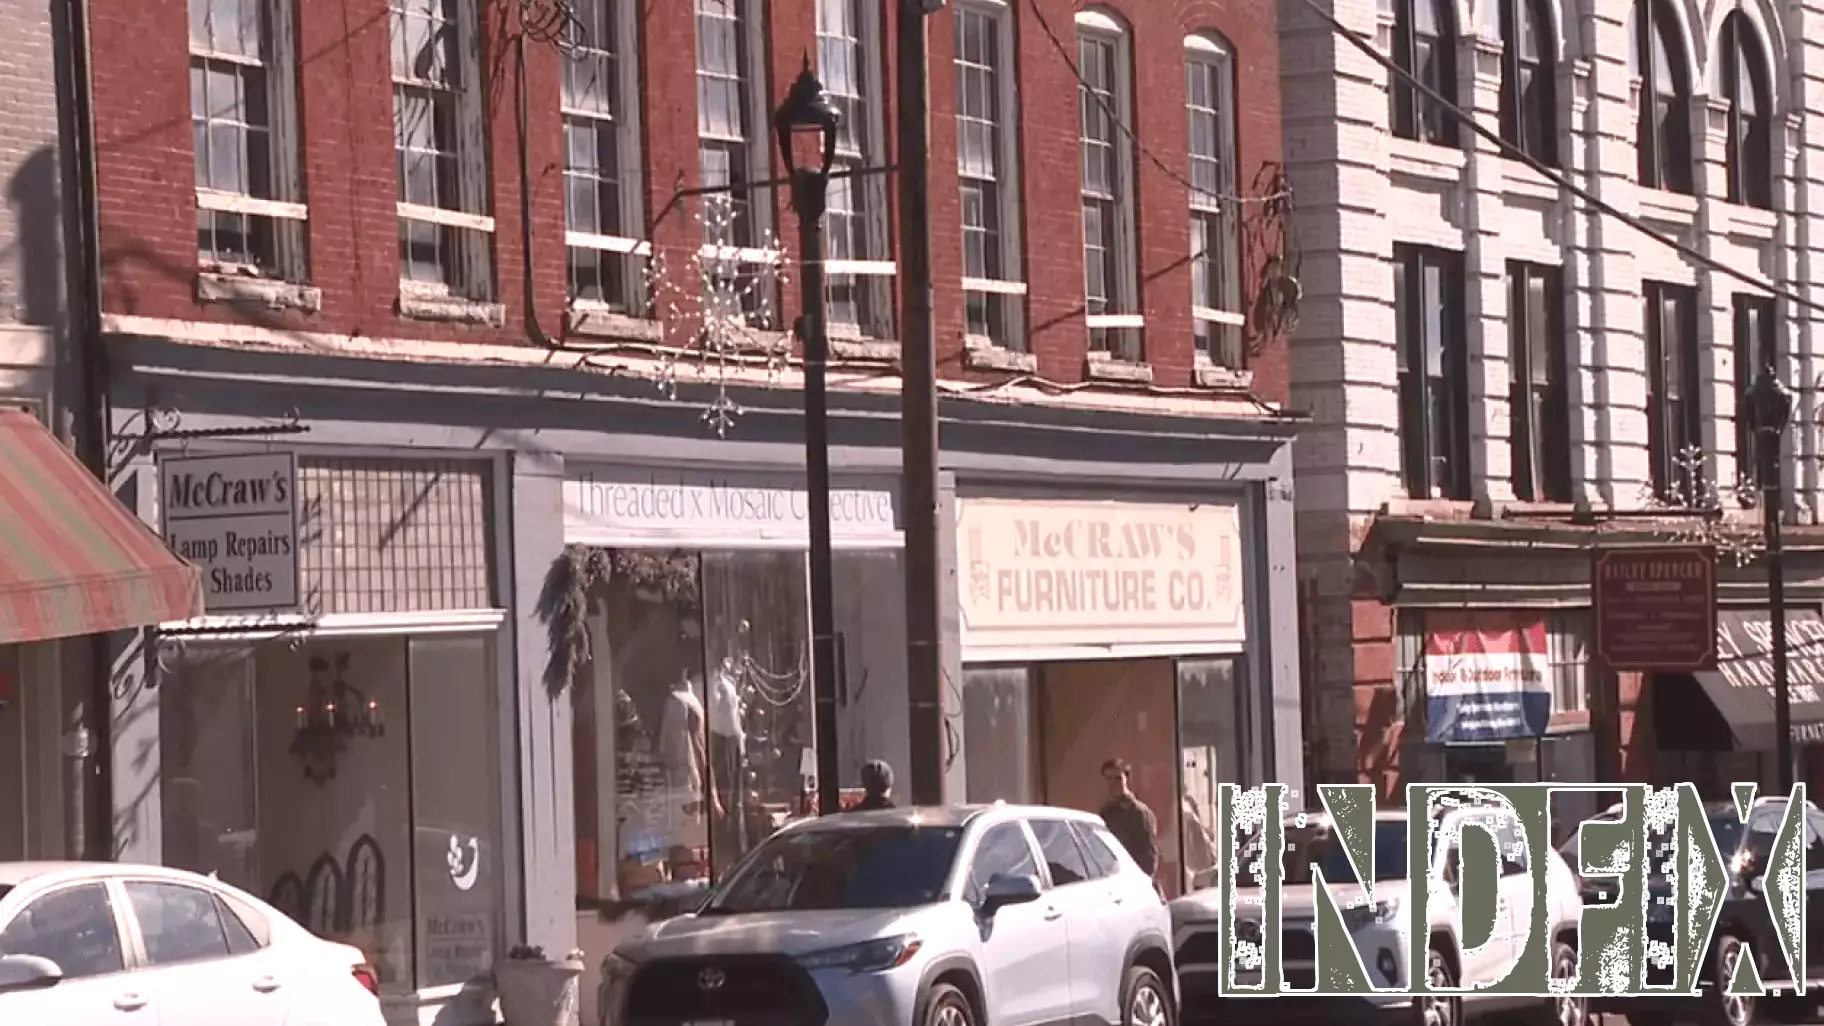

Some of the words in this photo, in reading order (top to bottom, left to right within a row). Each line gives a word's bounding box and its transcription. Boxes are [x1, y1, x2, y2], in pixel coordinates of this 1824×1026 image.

[169, 470, 288, 508] McCraw's
[577, 471, 683, 520] Threaded
[708, 478, 784, 521] Mosaic
[790, 480, 890, 523] Cective
[170, 532, 218, 563] Lamp
[226, 529, 290, 561] Repairs
[1013, 518, 1196, 561] McCRAW'S
[210, 565, 273, 594] Shades
[997, 568, 1157, 613] FURNITURE
[1168, 569, 1213, 611] CO.
